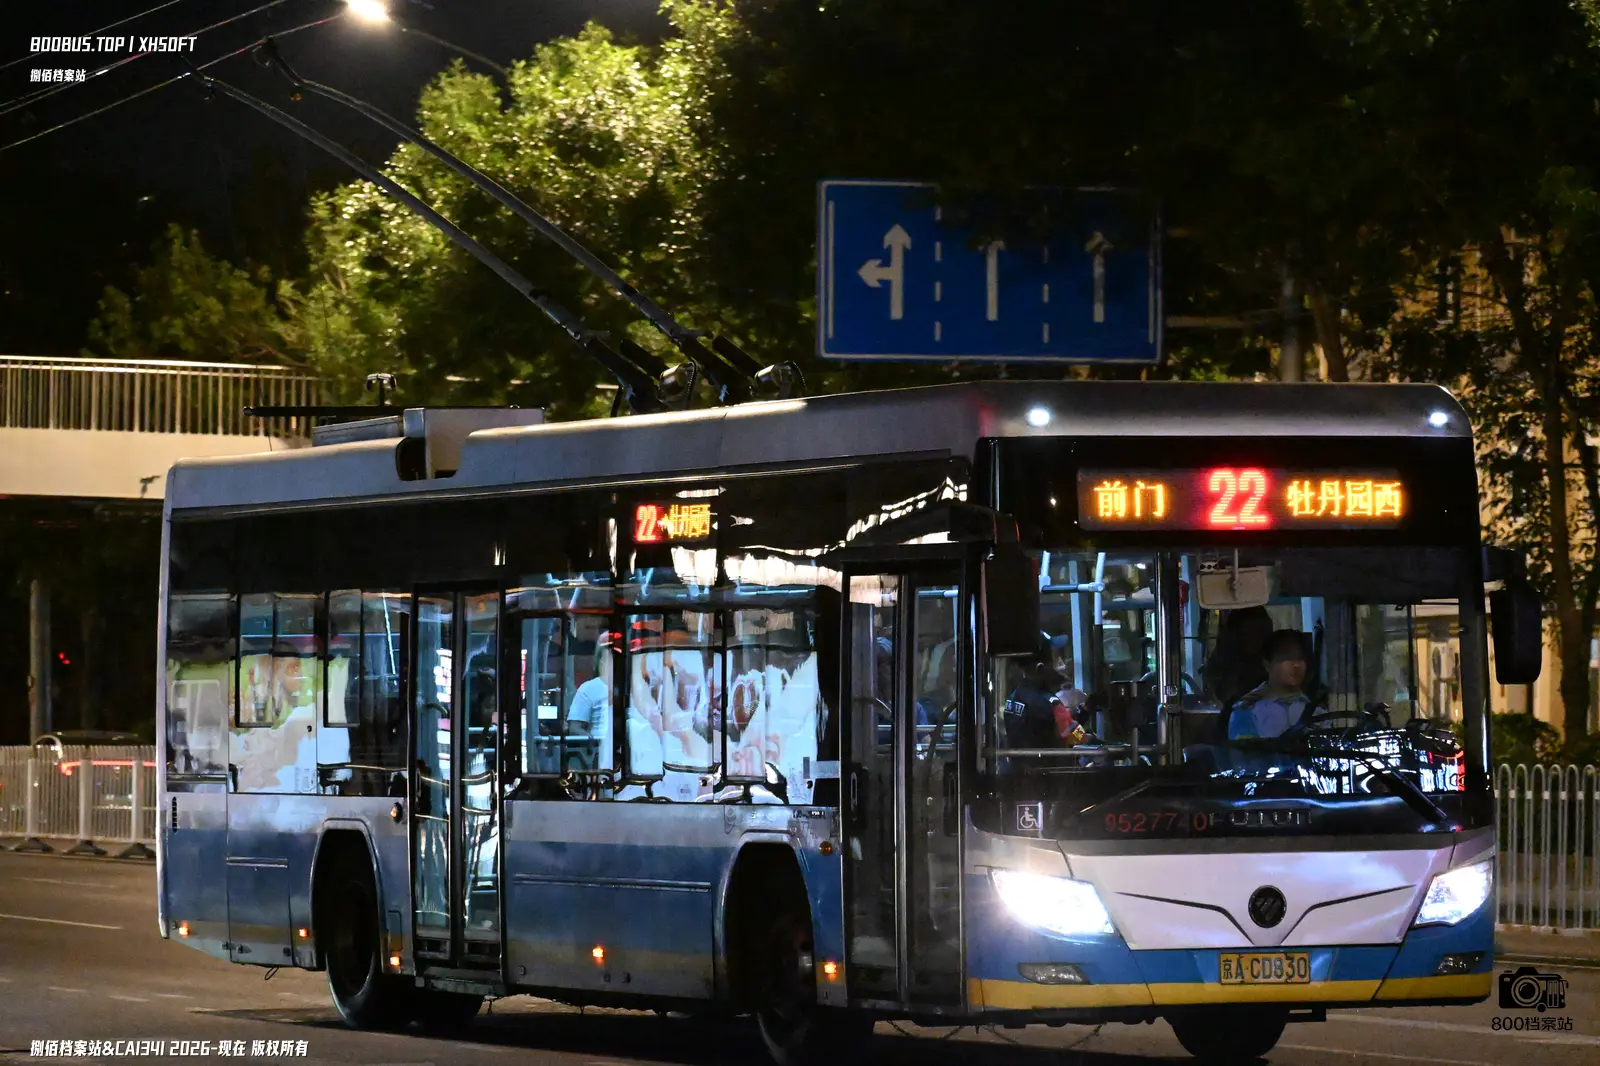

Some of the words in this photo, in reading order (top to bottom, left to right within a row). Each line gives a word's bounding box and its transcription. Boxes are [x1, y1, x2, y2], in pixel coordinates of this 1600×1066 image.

[1094, 480, 1165, 518] 前门
[1209, 471, 1268, 523] 22
[1286, 480, 1402, 517] 牡丹园西
[635, 503, 657, 541] 22
